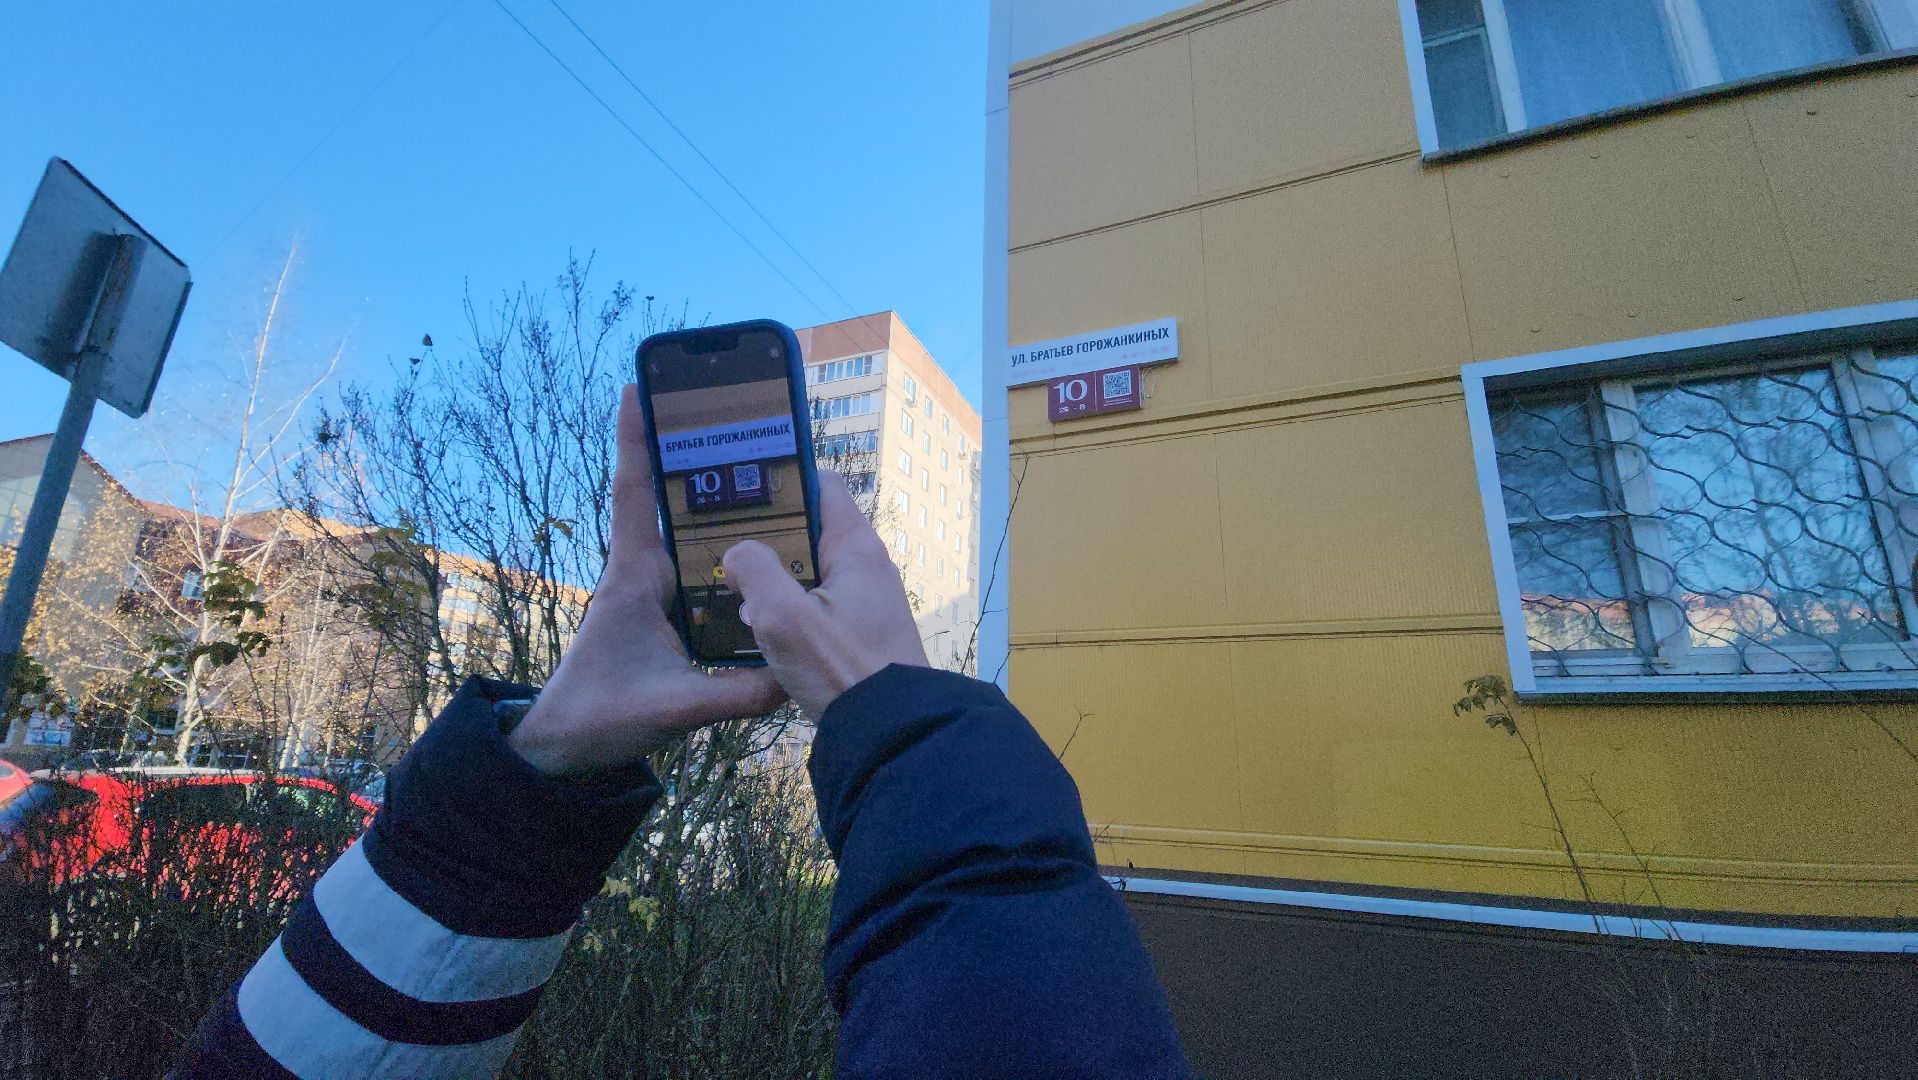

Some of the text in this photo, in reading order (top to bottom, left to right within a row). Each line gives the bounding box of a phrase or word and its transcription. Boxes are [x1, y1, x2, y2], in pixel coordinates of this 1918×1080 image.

[1011, 327, 1169, 367] УЛ. БРАТЬЕВ ГОРОЖАНКИНЫХ
[1053, 379, 1088, 404] 10
[665, 423, 790, 453] БРАТЬЕВ ГОРОЖАНКИНЫХ
[690, 471, 721, 494] 10
